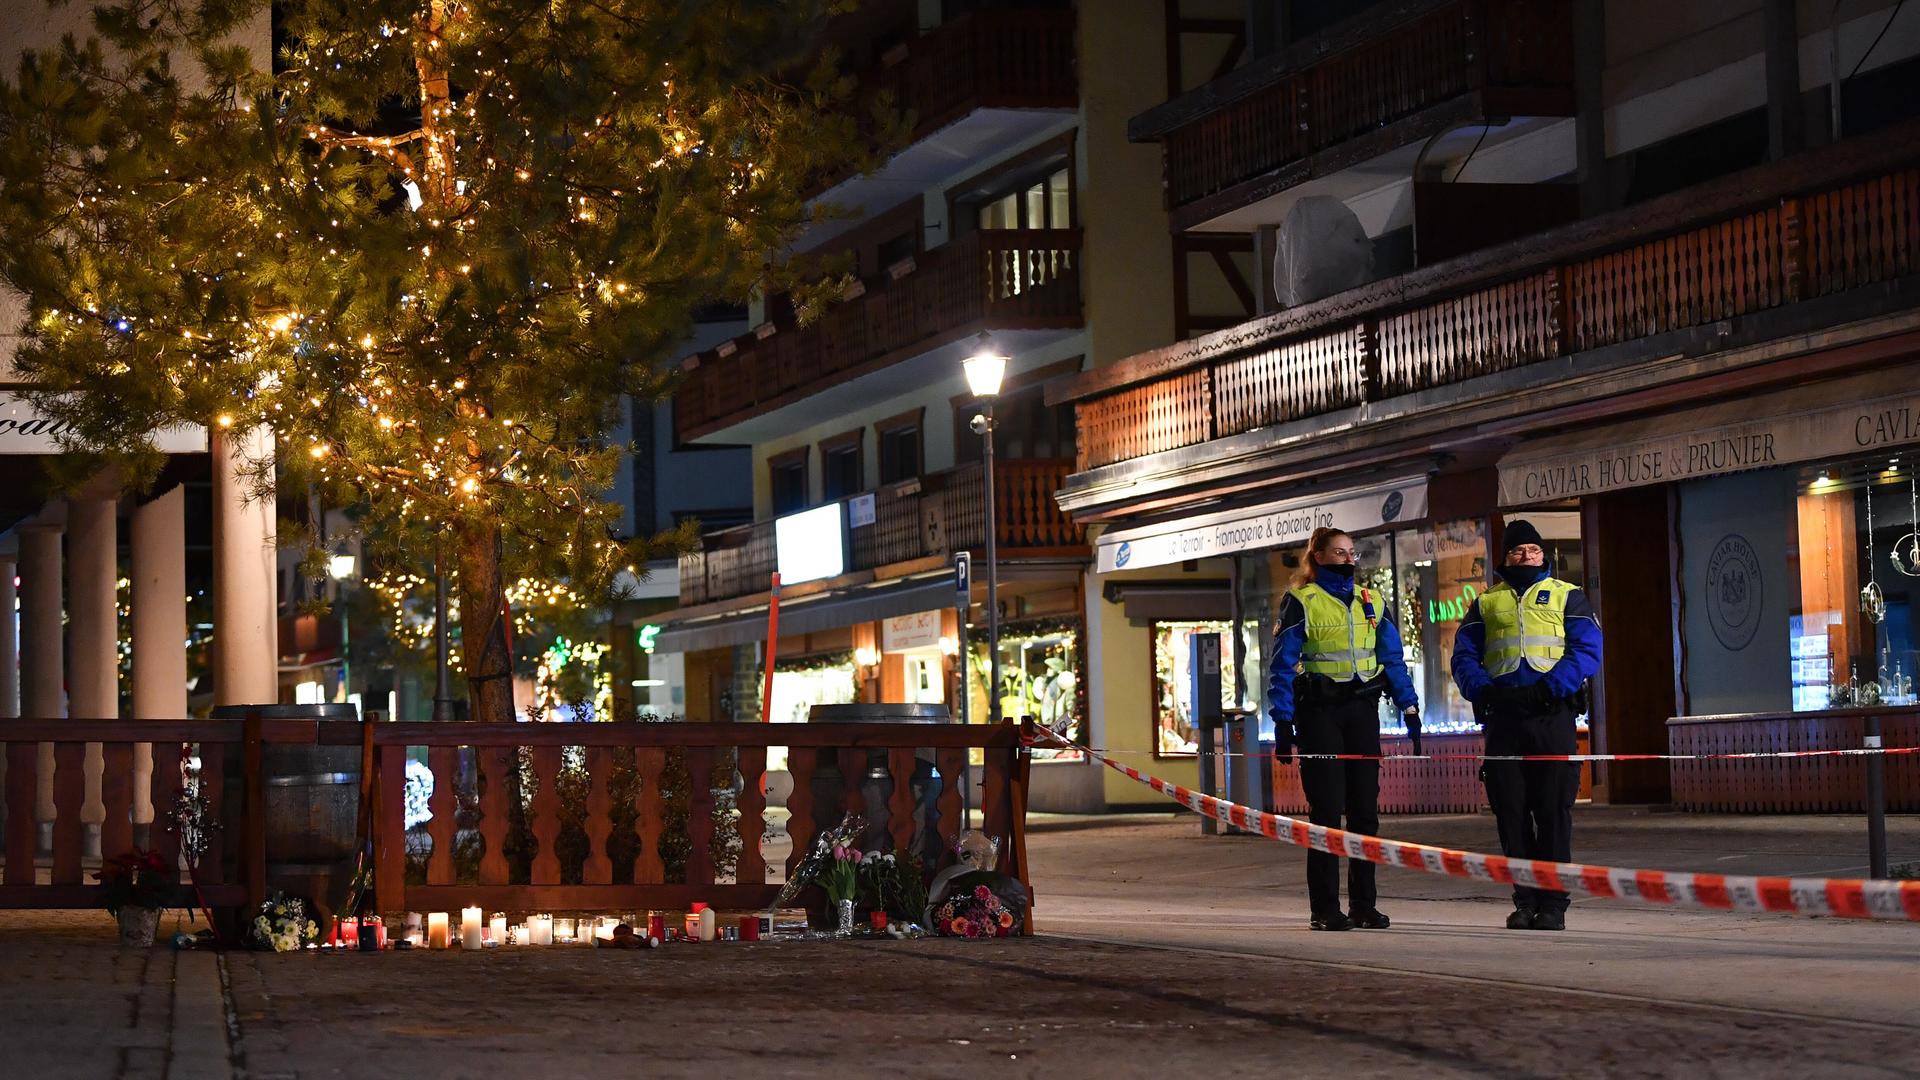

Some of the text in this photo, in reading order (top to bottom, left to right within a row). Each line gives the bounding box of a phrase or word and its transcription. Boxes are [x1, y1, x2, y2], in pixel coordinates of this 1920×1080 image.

[1525, 432, 1777, 499] CAVIAR HOUSE & PRUNIER
[1179, 529, 1204, 553] Terroir
[1266, 517, 1273, 538] &
[1276, 509, 1312, 542] épicerie
[1314, 506, 1334, 531] fine
[958, 561, 966, 588] P
